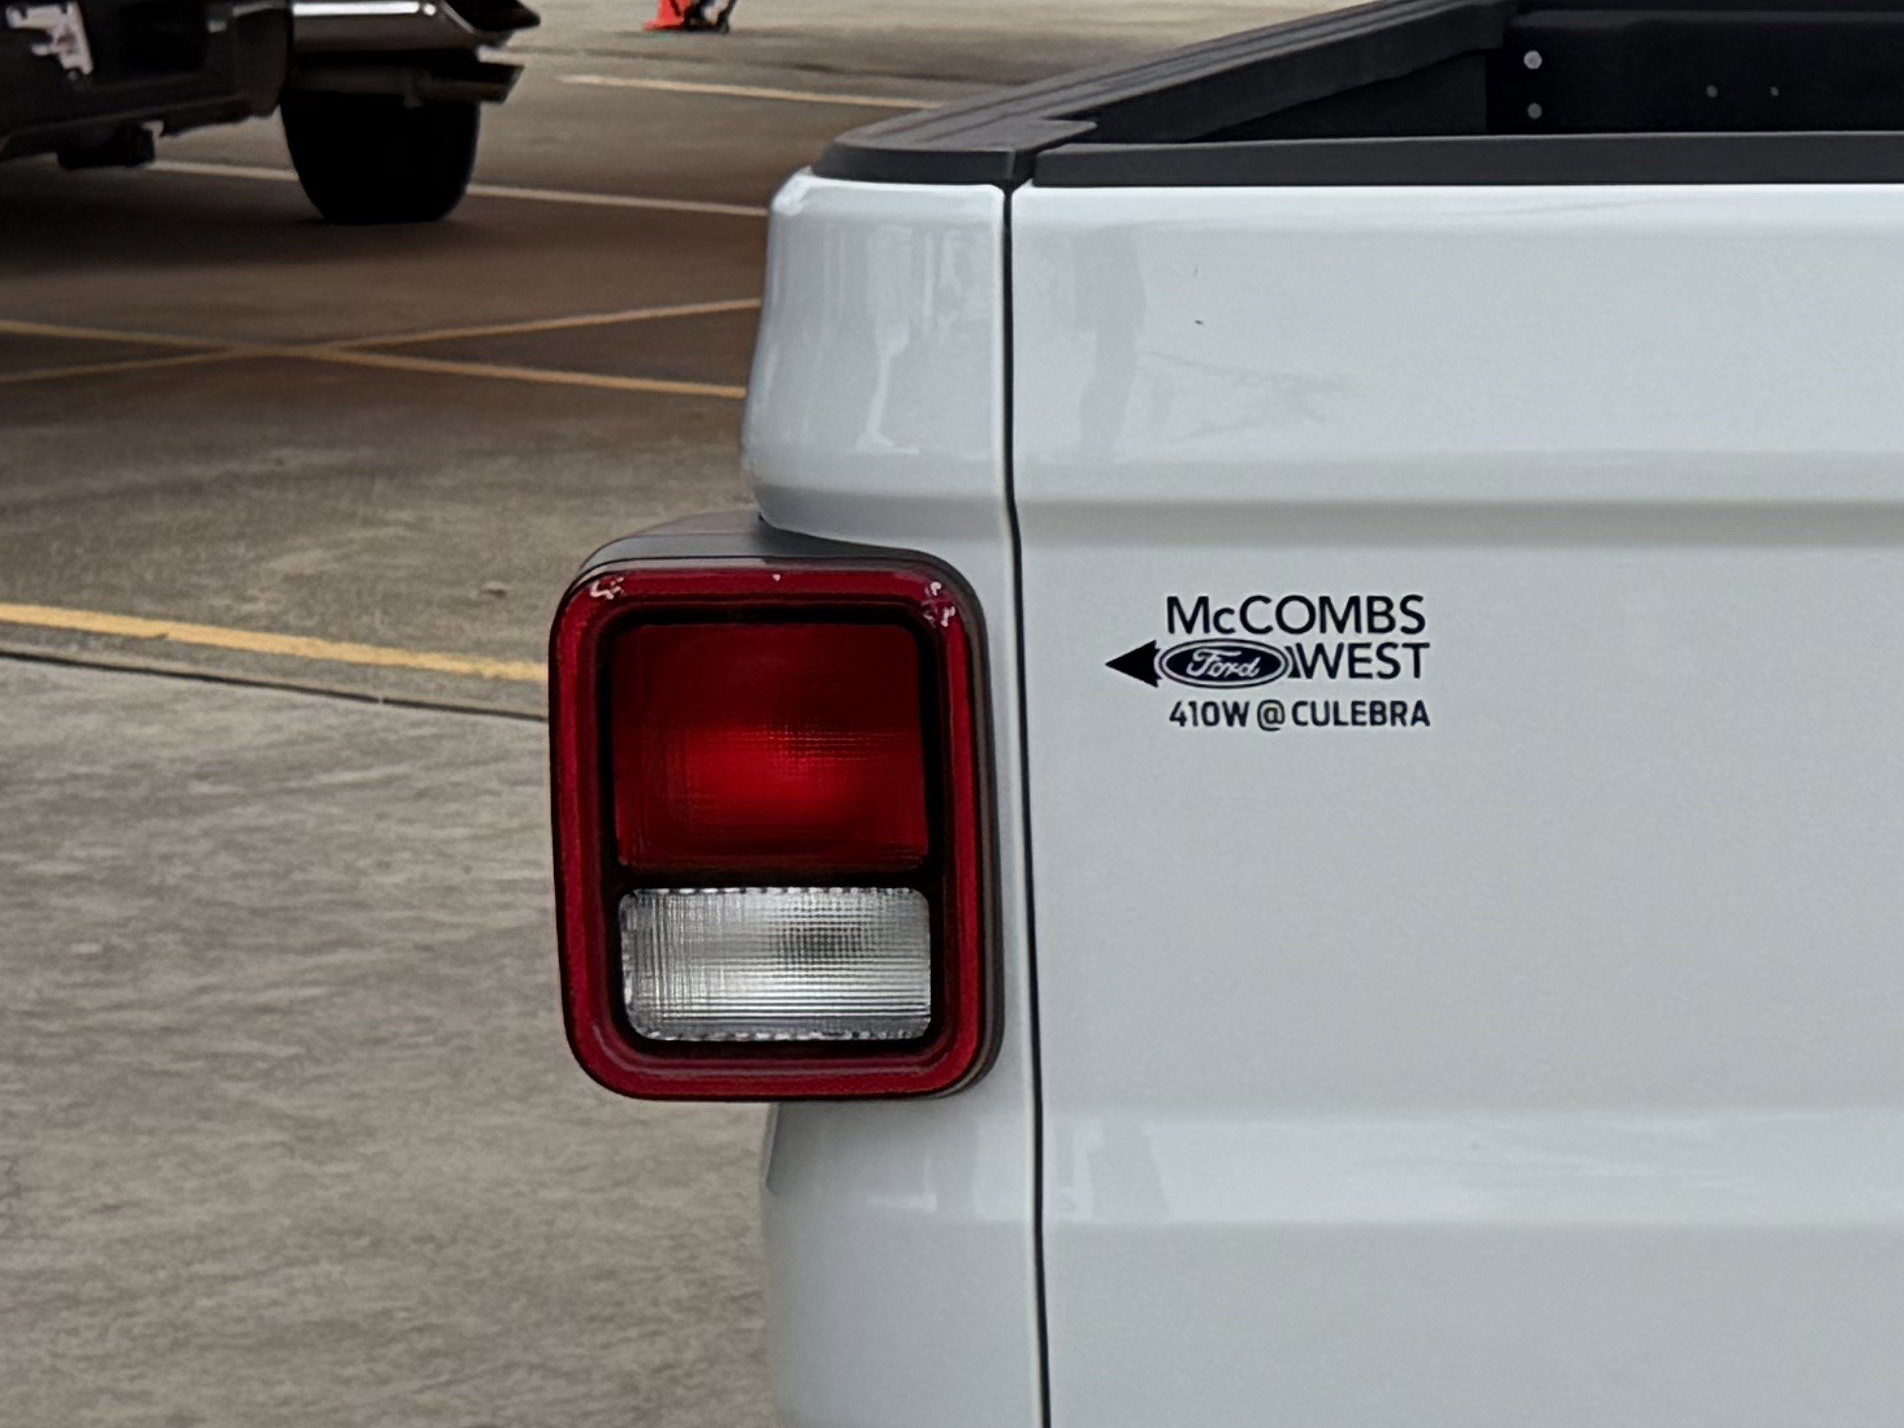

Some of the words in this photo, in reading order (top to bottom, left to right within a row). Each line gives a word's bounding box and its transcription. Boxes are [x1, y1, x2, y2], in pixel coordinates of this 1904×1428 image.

[1165, 594, 1426, 635] McCOMBS
[1184, 645, 1262, 679] Ford
[1297, 642, 1431, 680] WEST
